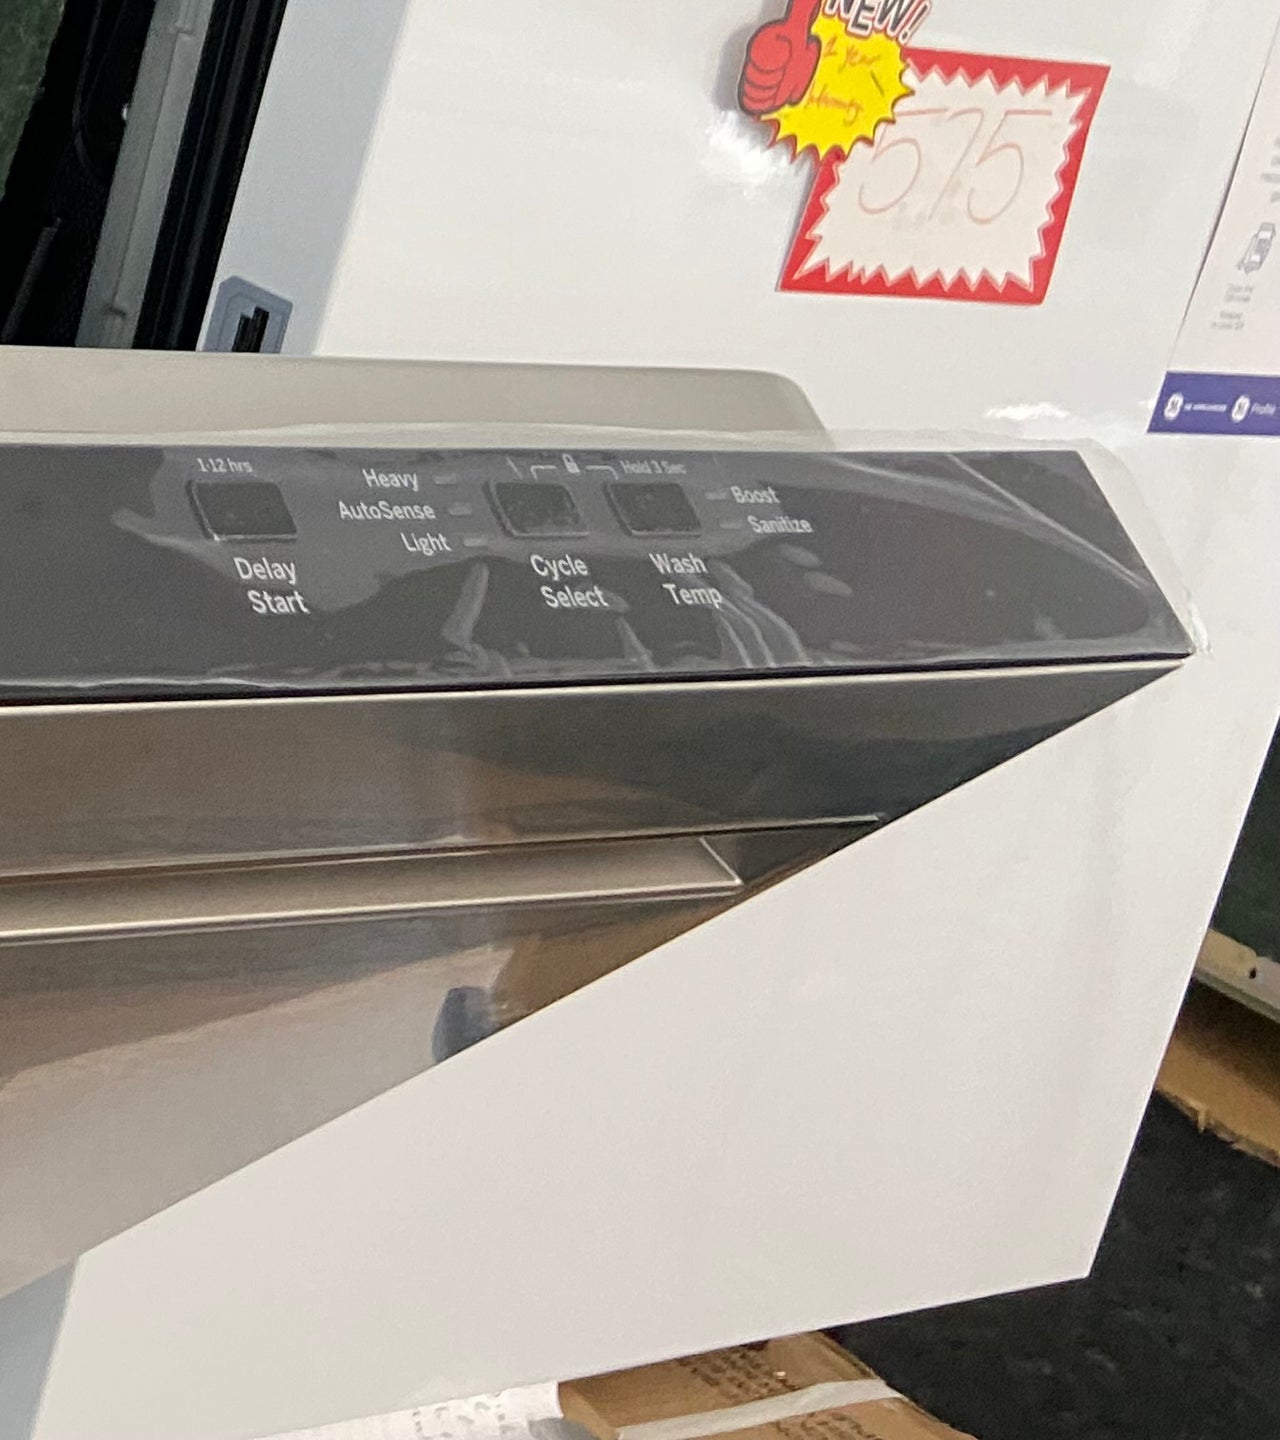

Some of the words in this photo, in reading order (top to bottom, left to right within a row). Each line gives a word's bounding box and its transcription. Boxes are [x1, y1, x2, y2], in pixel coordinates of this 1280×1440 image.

[858, 107, 1053, 226] 575
[362, 468, 419, 492] Heavy
[730, 485, 781, 504] Boost
[338, 500, 436, 520] AutoSense
[747, 515, 814, 534] Sanitize
[400, 532, 452, 556] Light
[233, 556, 296, 585] Delay
[530, 554, 589, 581] Cycle
[648, 552, 709, 574] Wash
[247, 589, 310, 614] Start
[540, 585, 609, 608] Select
[661, 582, 724, 609] Temp
